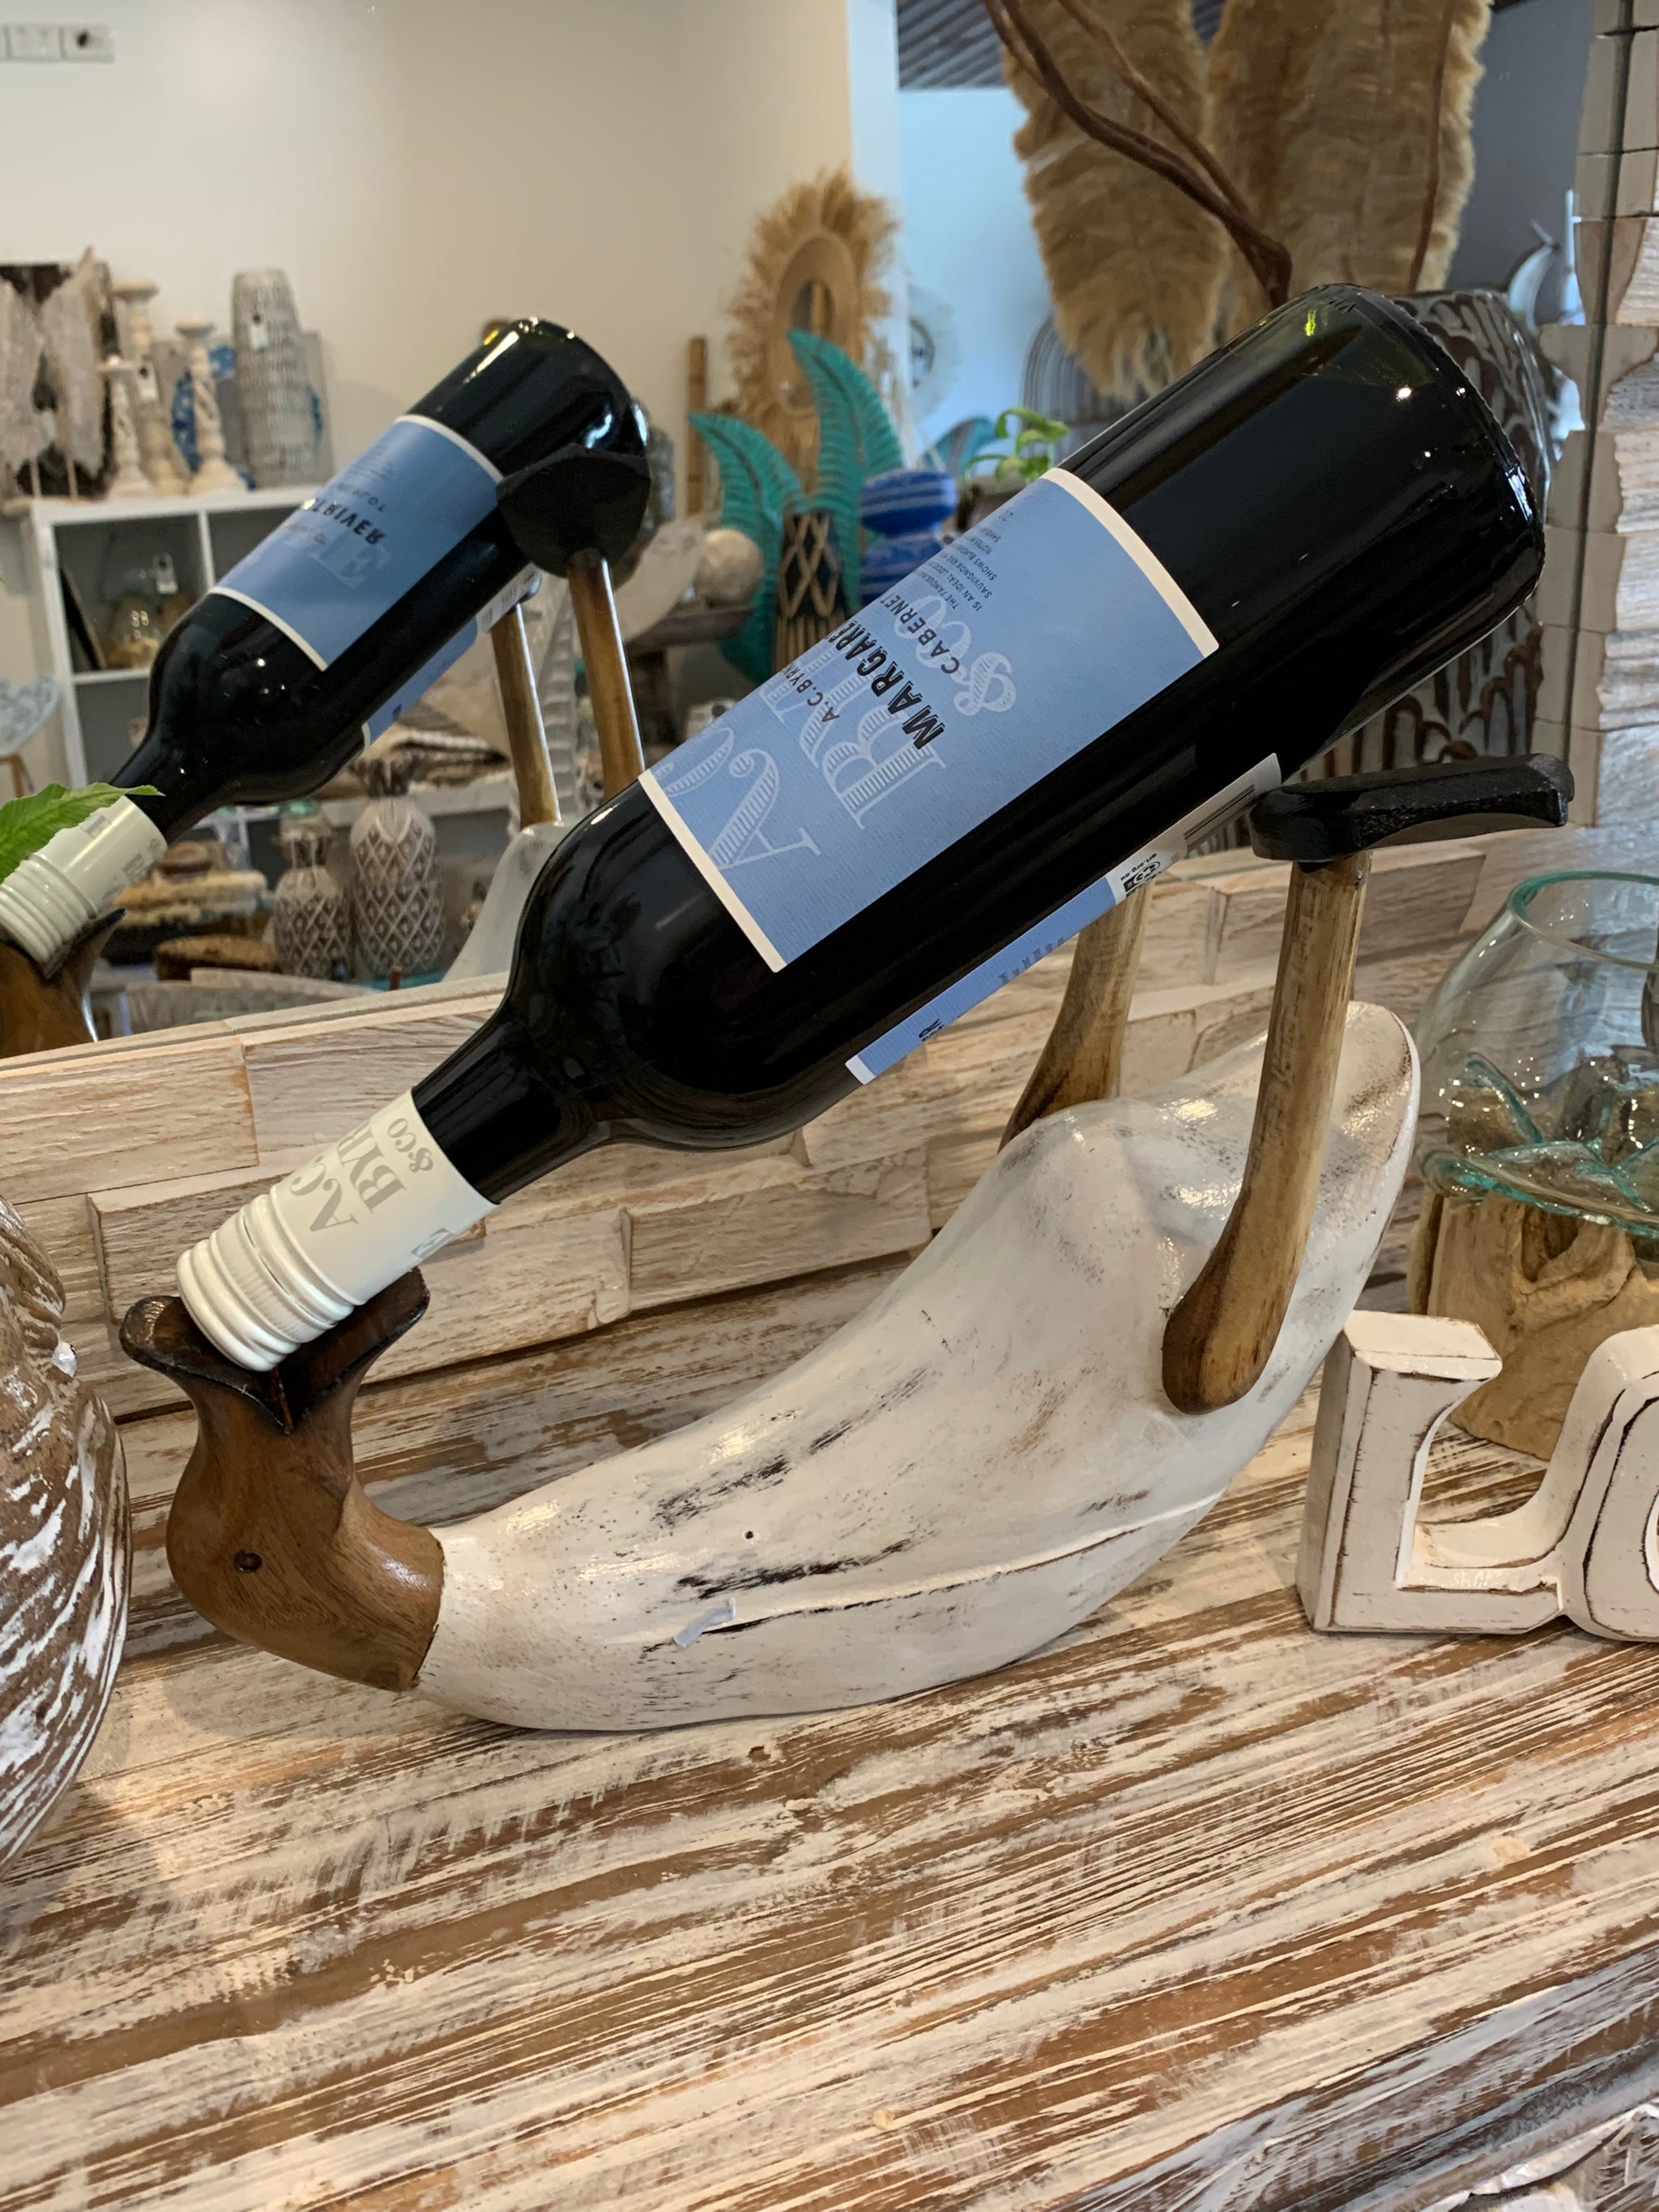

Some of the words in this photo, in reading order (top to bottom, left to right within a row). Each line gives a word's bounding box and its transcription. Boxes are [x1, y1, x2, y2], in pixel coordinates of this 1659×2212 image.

[972, 557, 997, 581] SHOWS
[945, 573, 965, 592] IDEAL
[944, 594, 959, 609] THE
[962, 590, 975, 601] AN
[971, 600, 983, 612] IS
[879, 591, 957, 674] CABERNET
